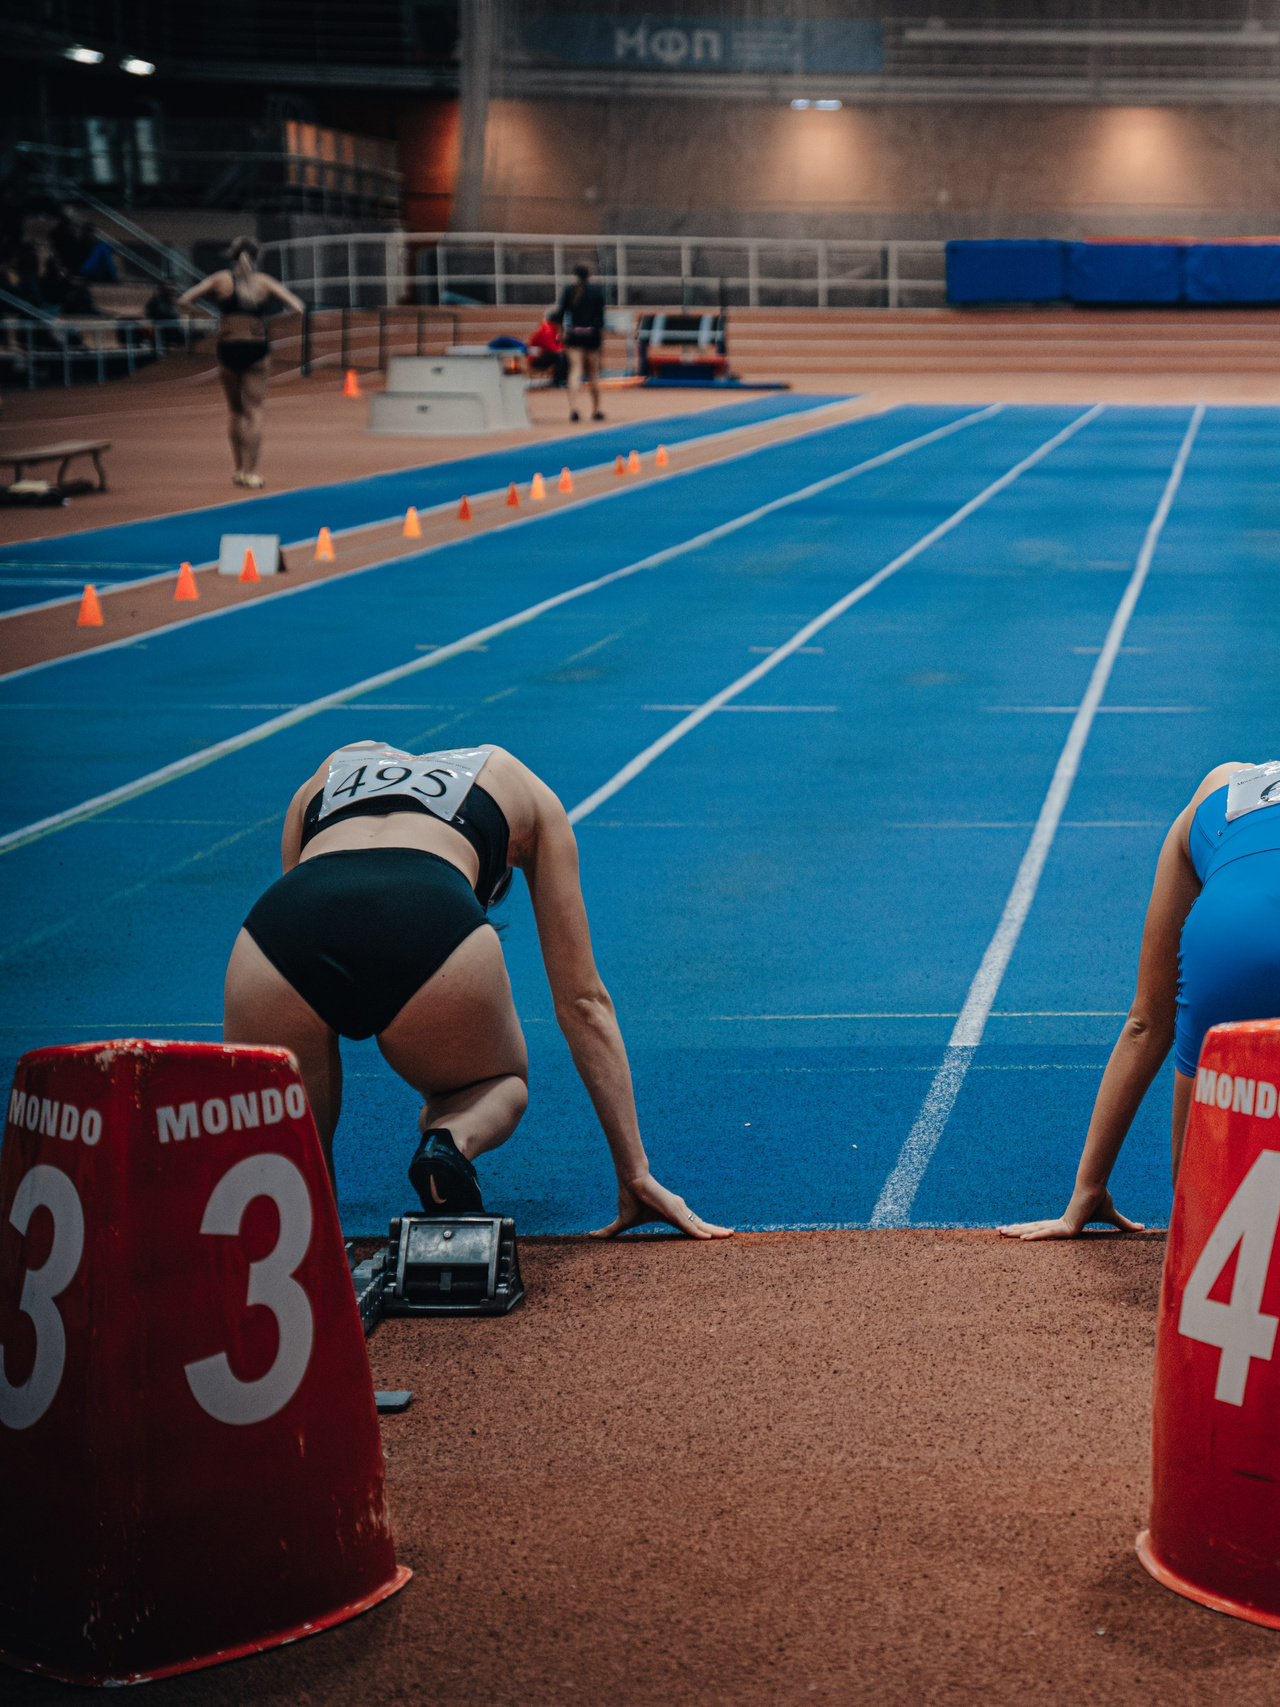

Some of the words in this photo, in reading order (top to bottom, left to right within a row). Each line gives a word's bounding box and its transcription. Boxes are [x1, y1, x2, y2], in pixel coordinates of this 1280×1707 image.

[332, 765, 454, 798] 495
[9, 1089, 102, 1146] MONDO
[156, 1083, 306, 1143] MONDO
[0, 1164, 84, 1430] 3
[184, 1153, 314, 1426] 3
